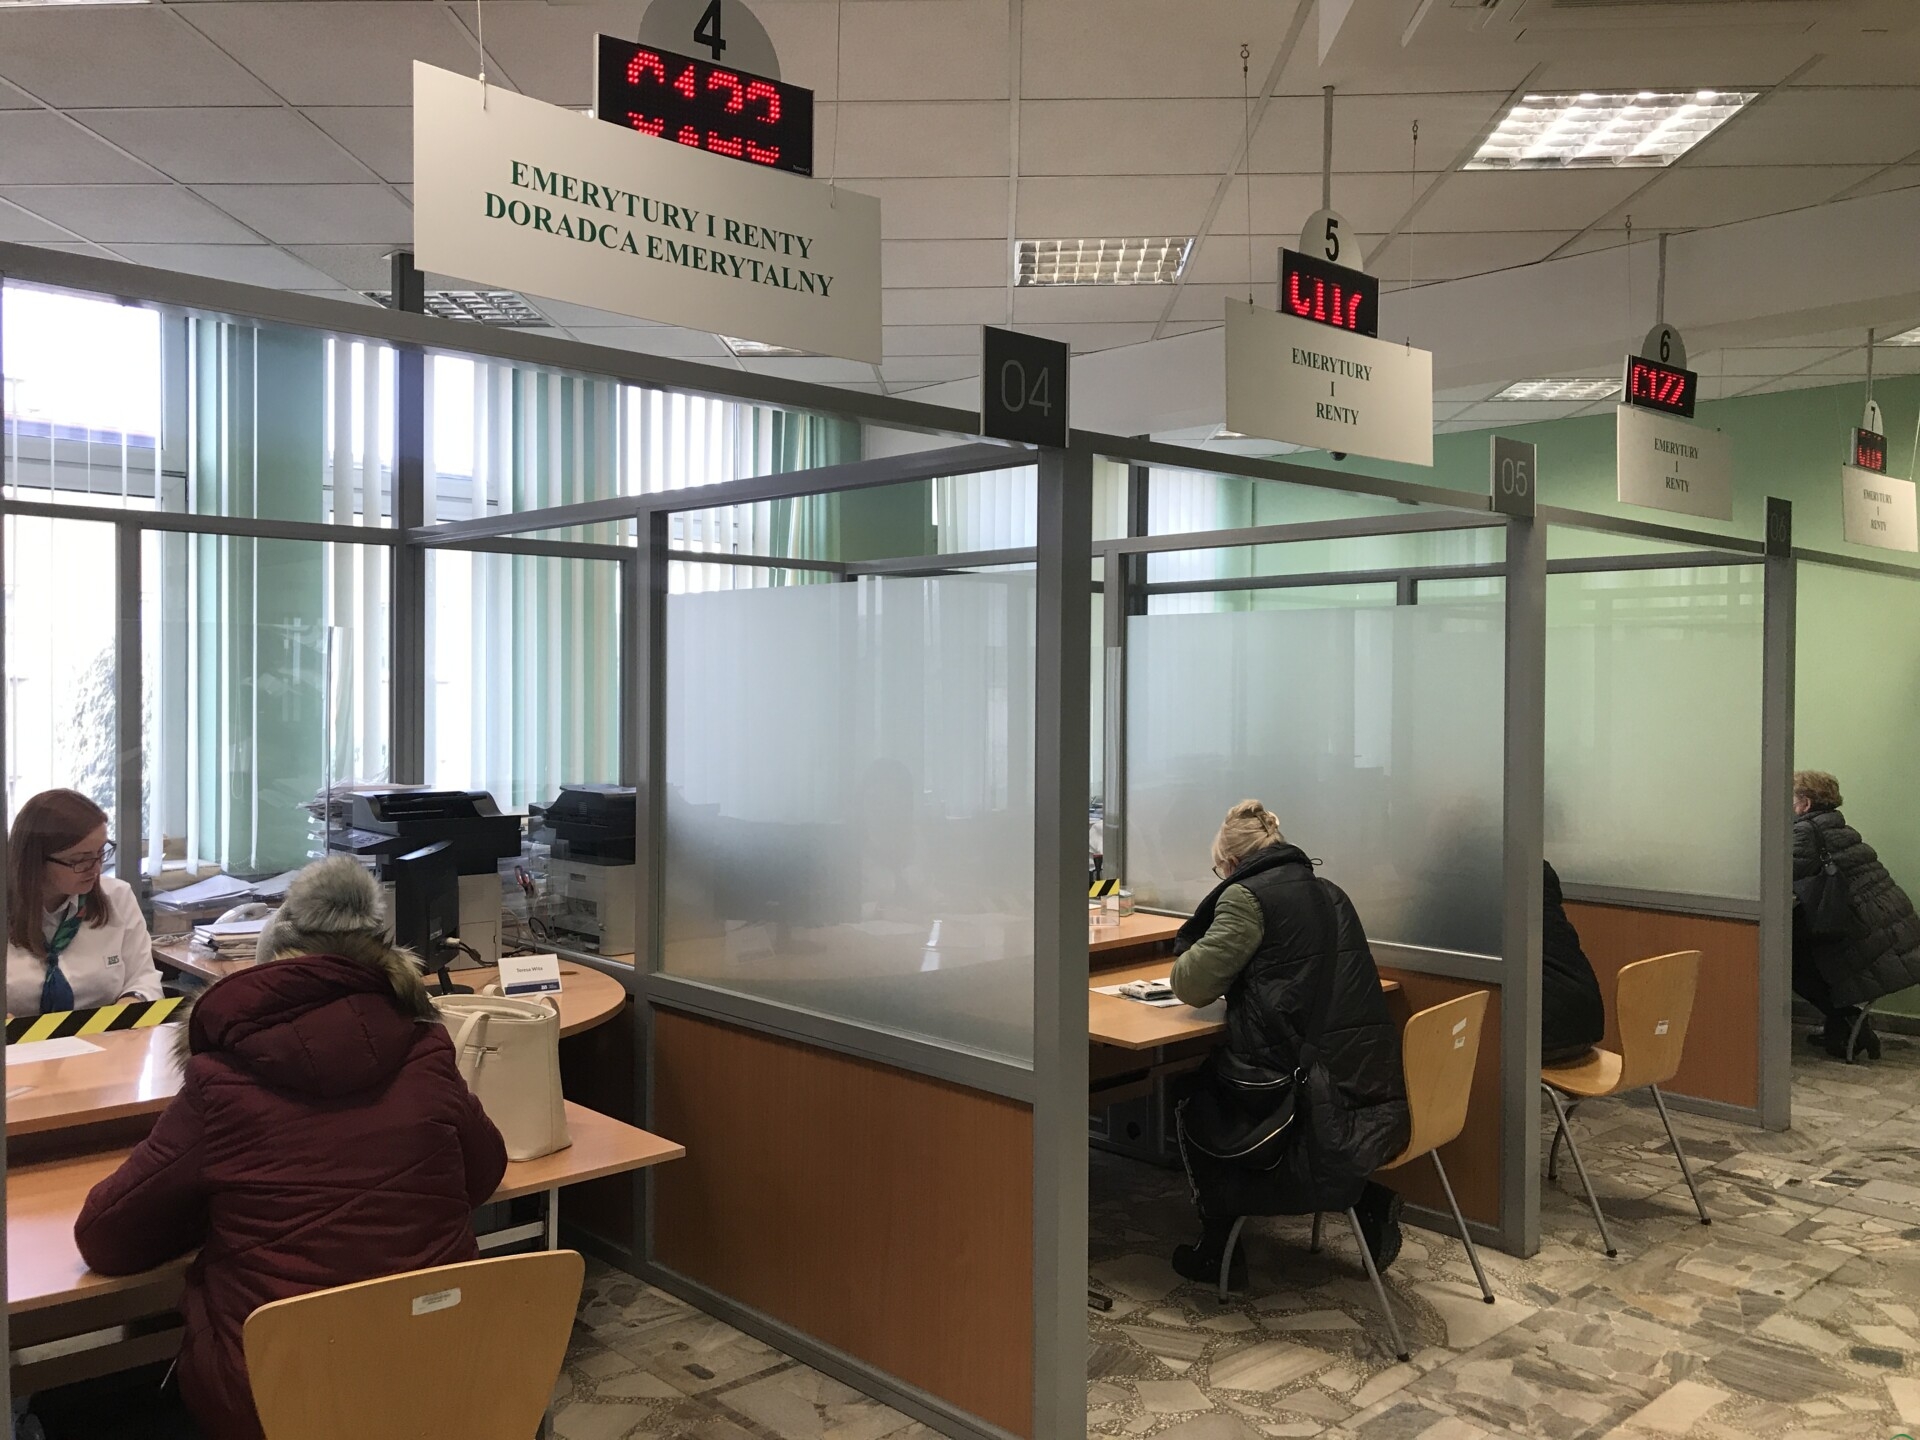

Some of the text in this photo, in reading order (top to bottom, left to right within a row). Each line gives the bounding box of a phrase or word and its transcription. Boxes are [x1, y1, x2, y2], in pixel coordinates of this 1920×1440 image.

[694, 0, 726, 61] 4
[510, 159, 813, 260] EMERYTURY I RENTY
[484, 192, 834, 297] DORADCA EMERYTALNY
[1324, 217, 1339, 262] 5
[1660, 330, 1671, 363] 6
[1292, 347, 1373, 382] EMERYTURY
[1001, 359, 1052, 417] 04
[1330, 381, 1335, 397] I
[1316, 401, 1360, 426] RENTY
[1870, 406, 1876, 431] 7
[1654, 437, 1699, 460] EMERYTURY
[1501, 457, 1528, 497] 05
[1674, 461, 1679, 473] I
[1665, 476, 1690, 493] RENTY
[1770, 512, 1788, 543] 06
[1870, 518, 1887, 532] RENTY
